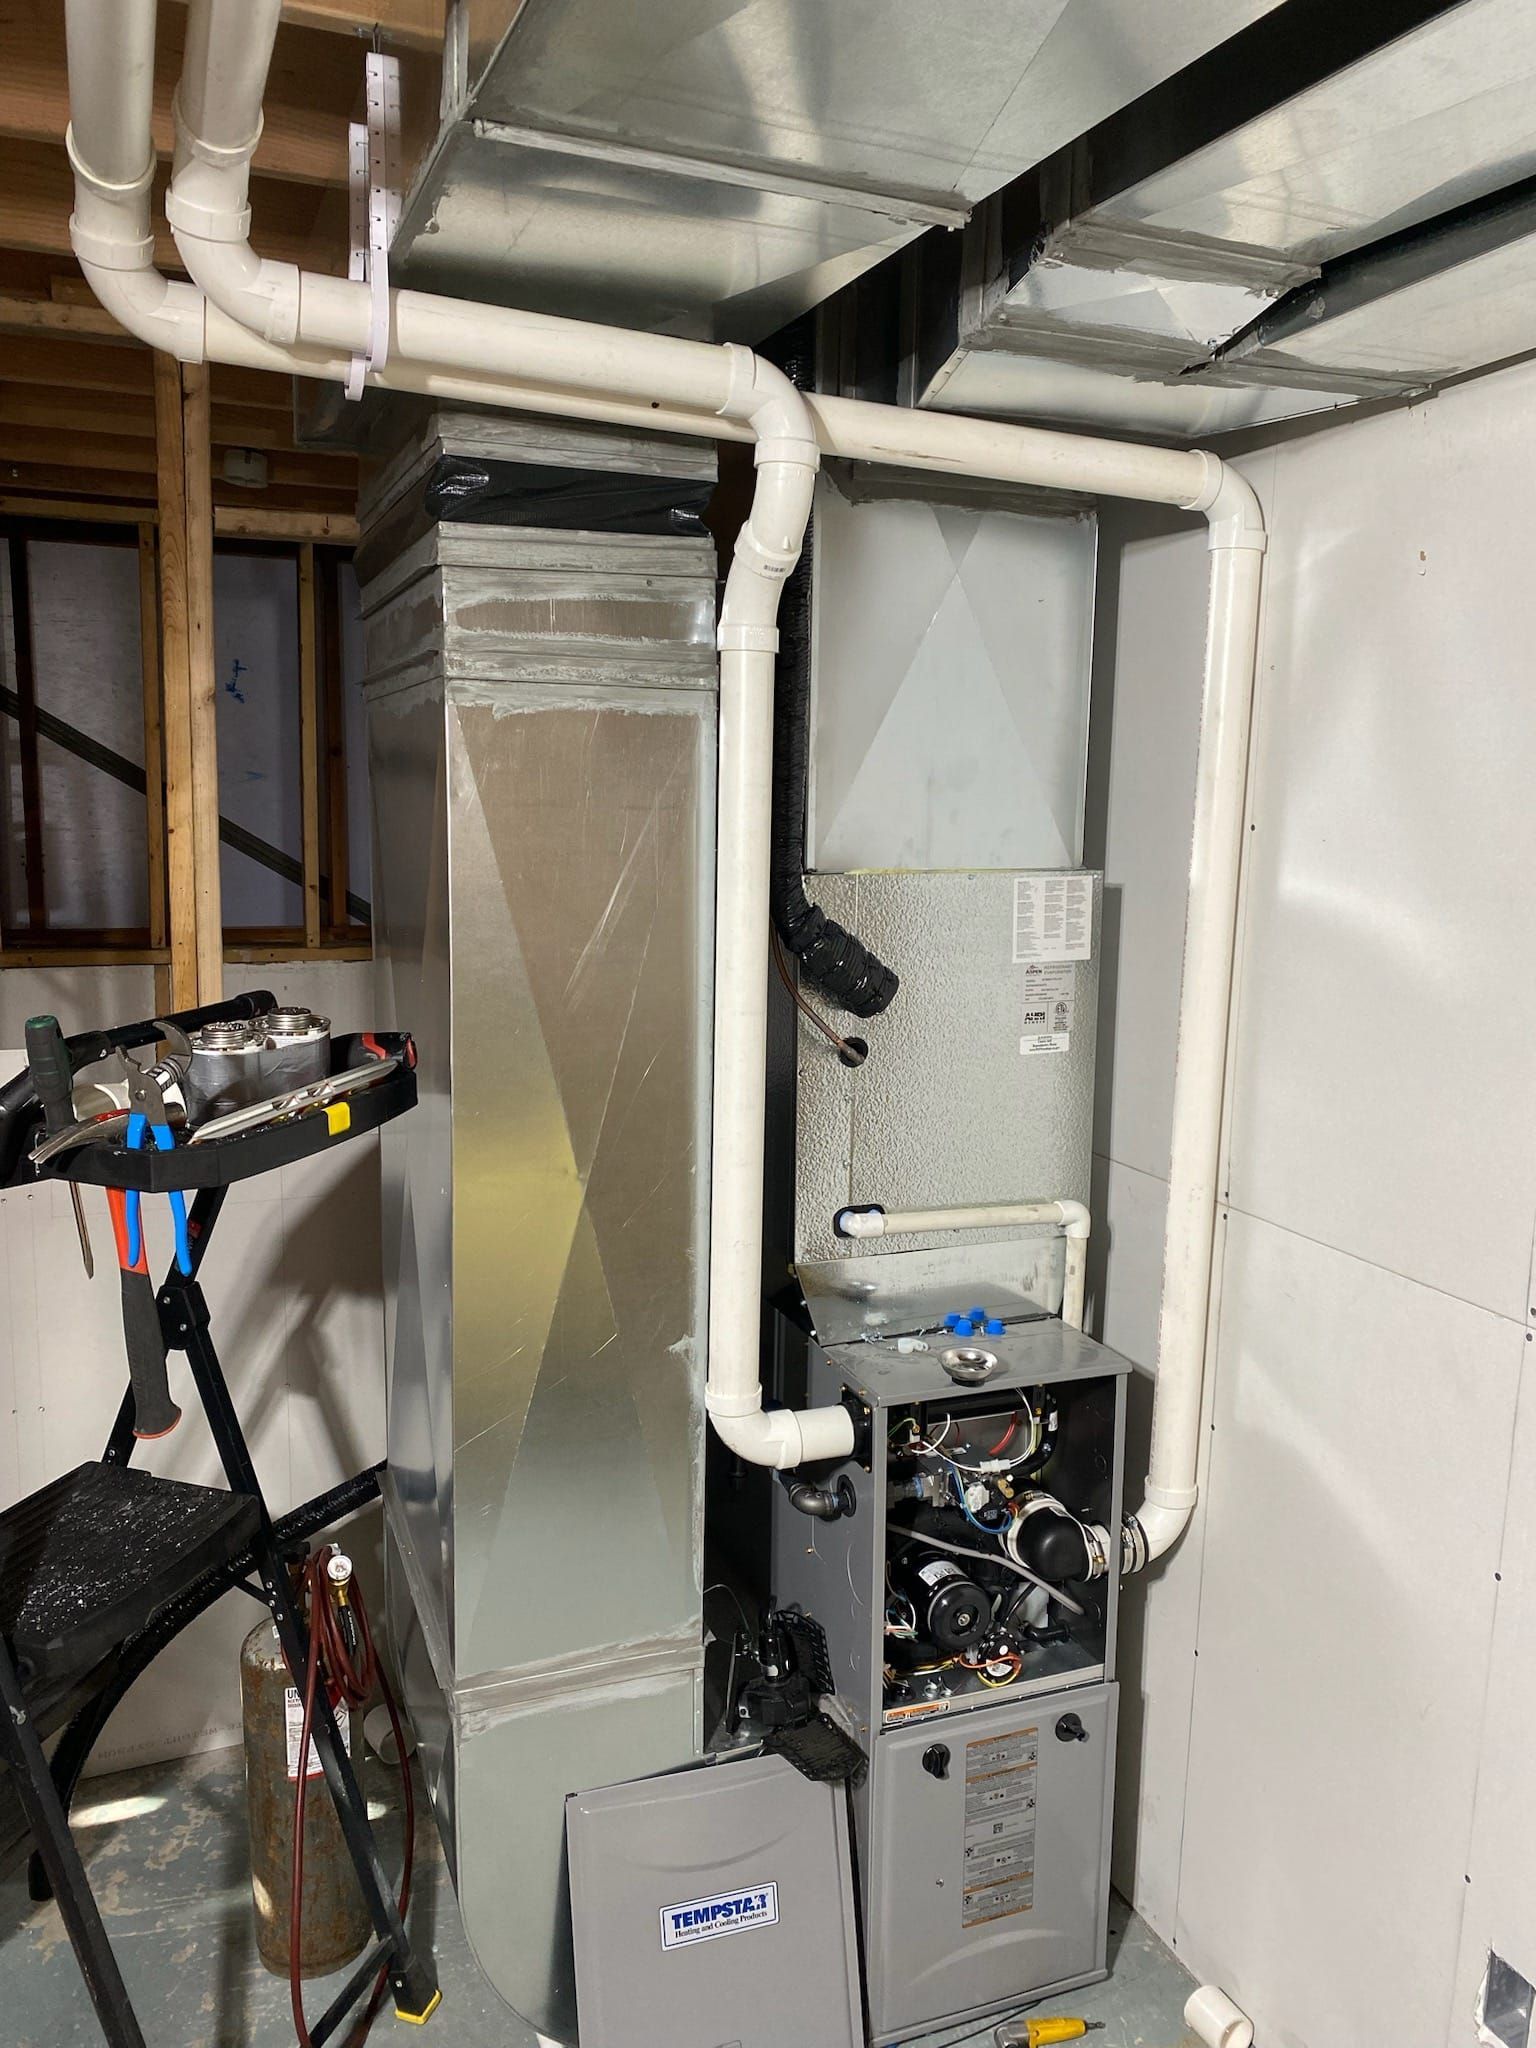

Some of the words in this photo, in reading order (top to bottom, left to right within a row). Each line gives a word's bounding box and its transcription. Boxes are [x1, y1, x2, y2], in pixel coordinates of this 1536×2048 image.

[675, 1926, 701, 1938] Heating
[701, 1922, 713, 1931] and
[714, 1917, 739, 1929] Cooling
[740, 1911, 768, 1922] Products
